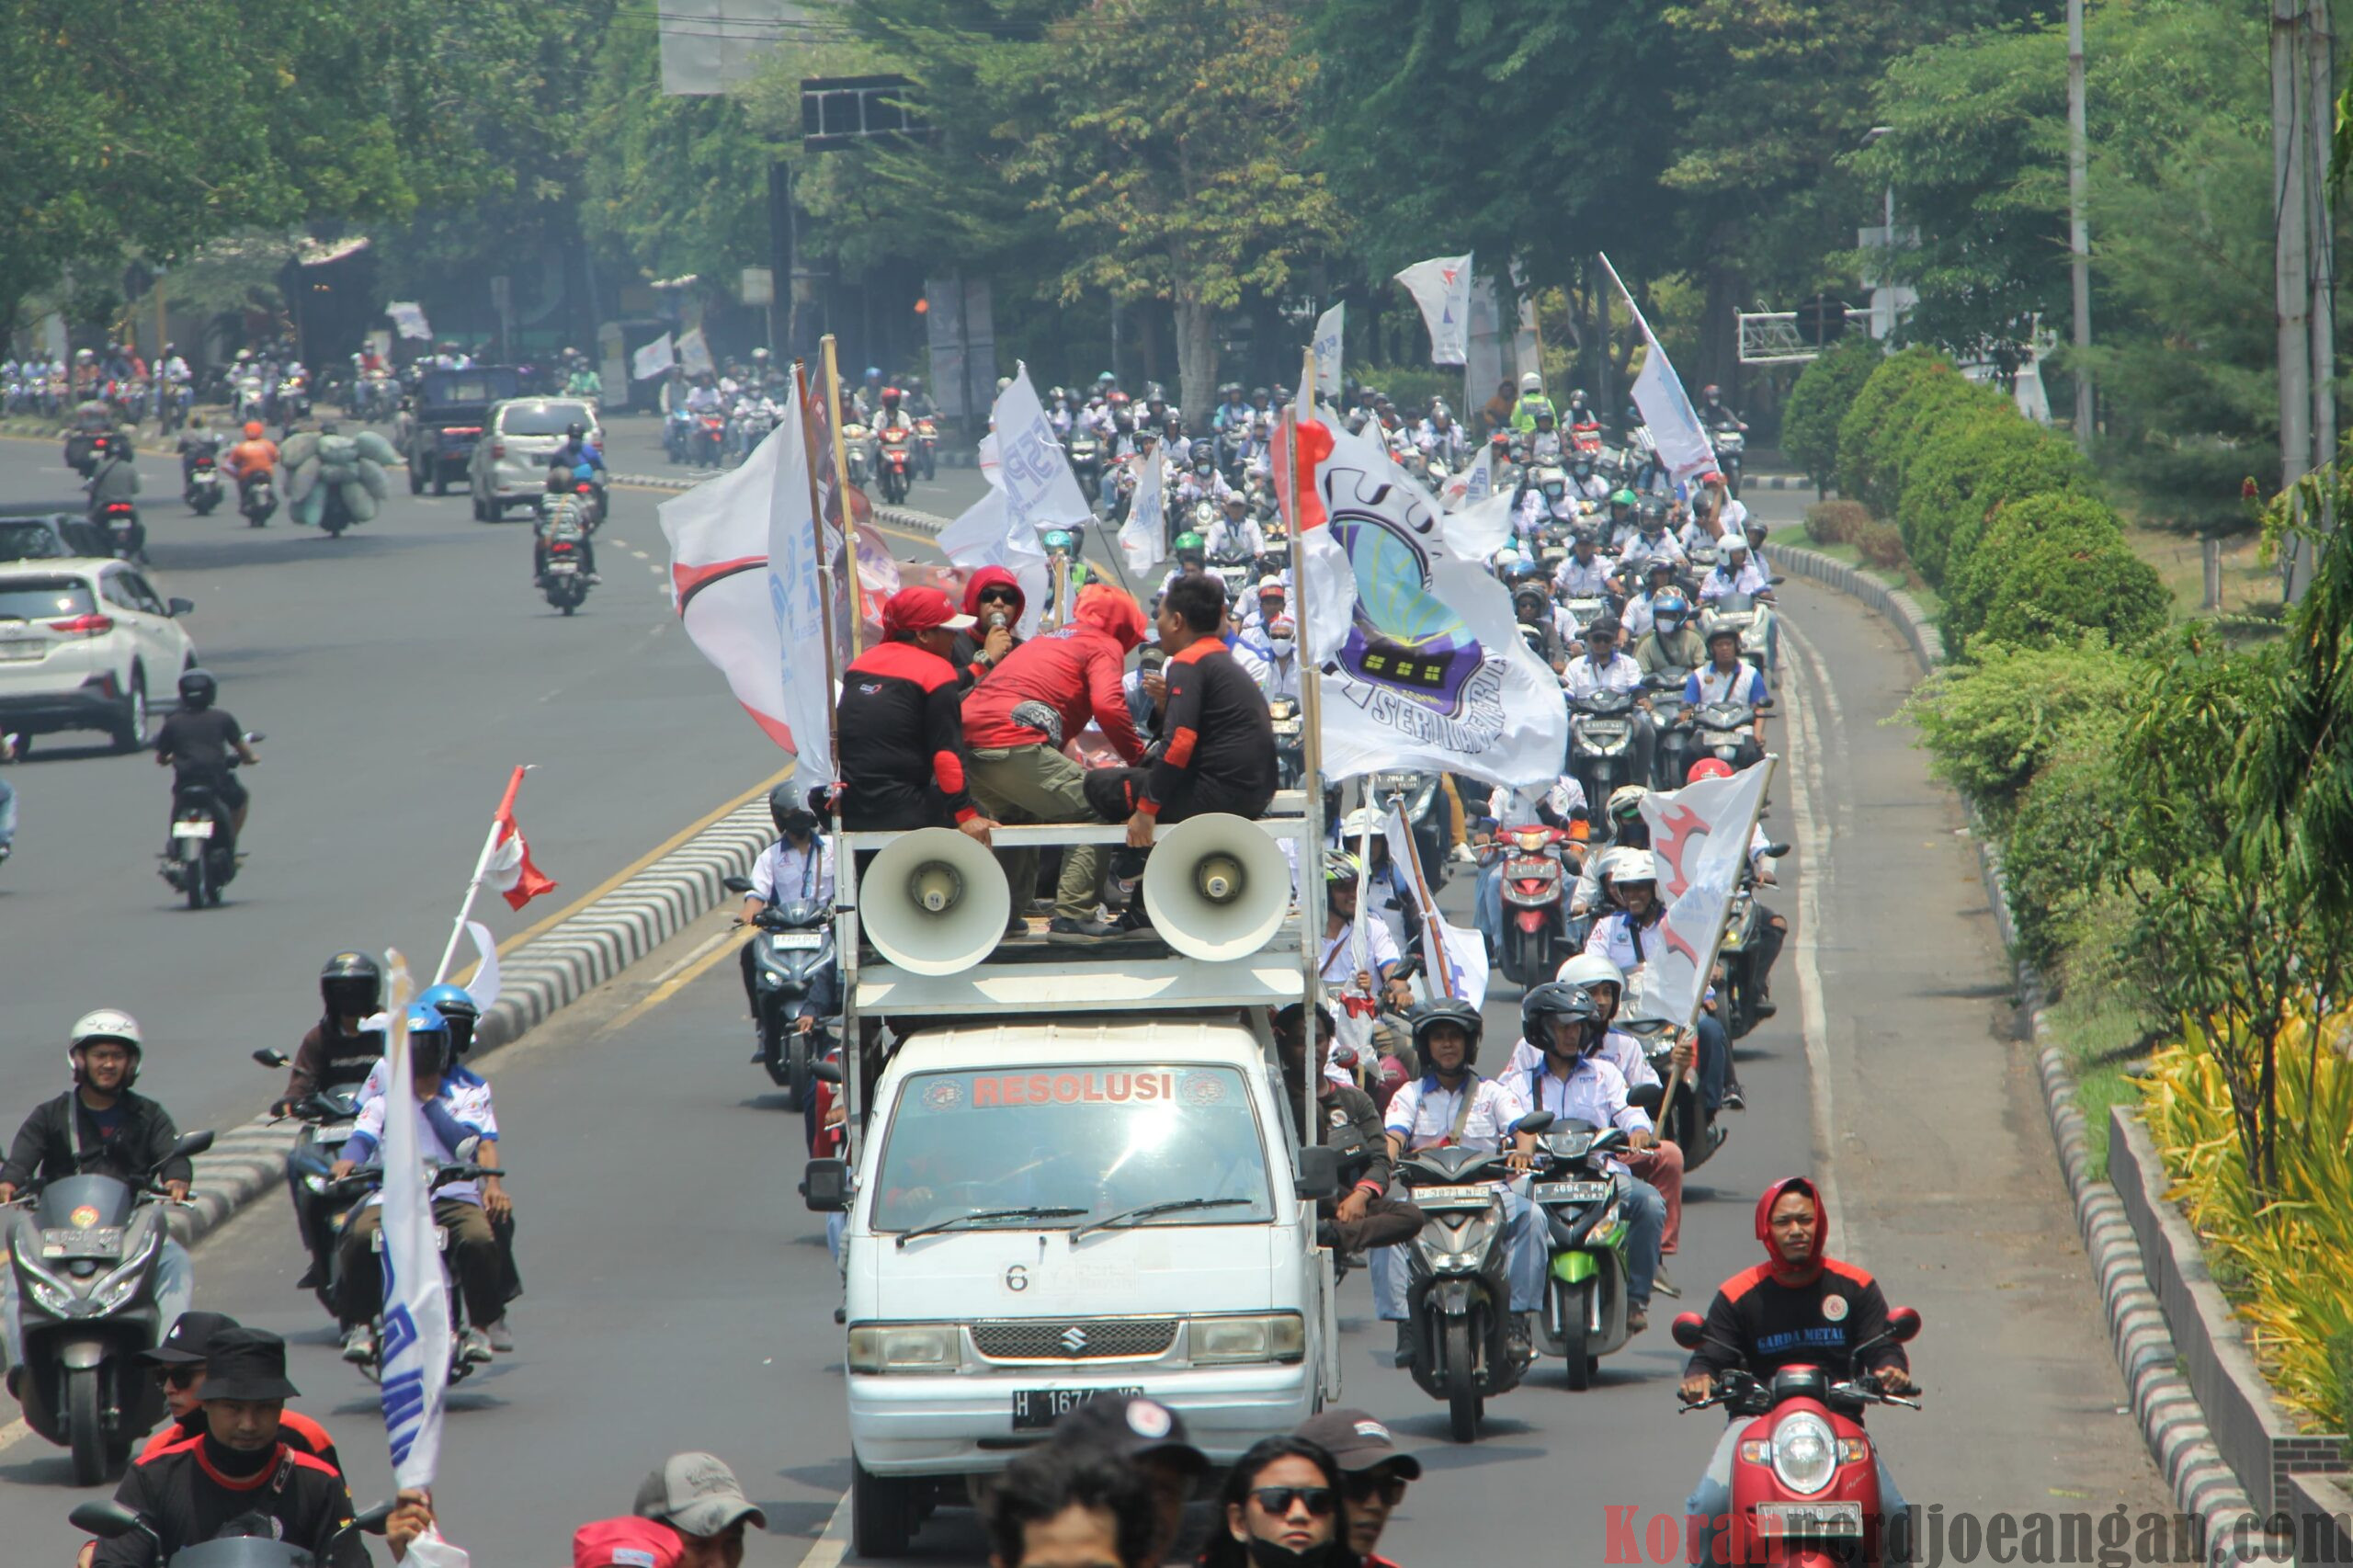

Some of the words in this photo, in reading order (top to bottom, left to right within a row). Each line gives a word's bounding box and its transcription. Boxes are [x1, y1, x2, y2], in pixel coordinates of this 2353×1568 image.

[972, 1074, 1171, 1107] RESOLUSI
[1006, 1265, 1029, 1292] 6
[1803, 1327, 1846, 1341] METAL
[1016, 1392, 1029, 1416] H
